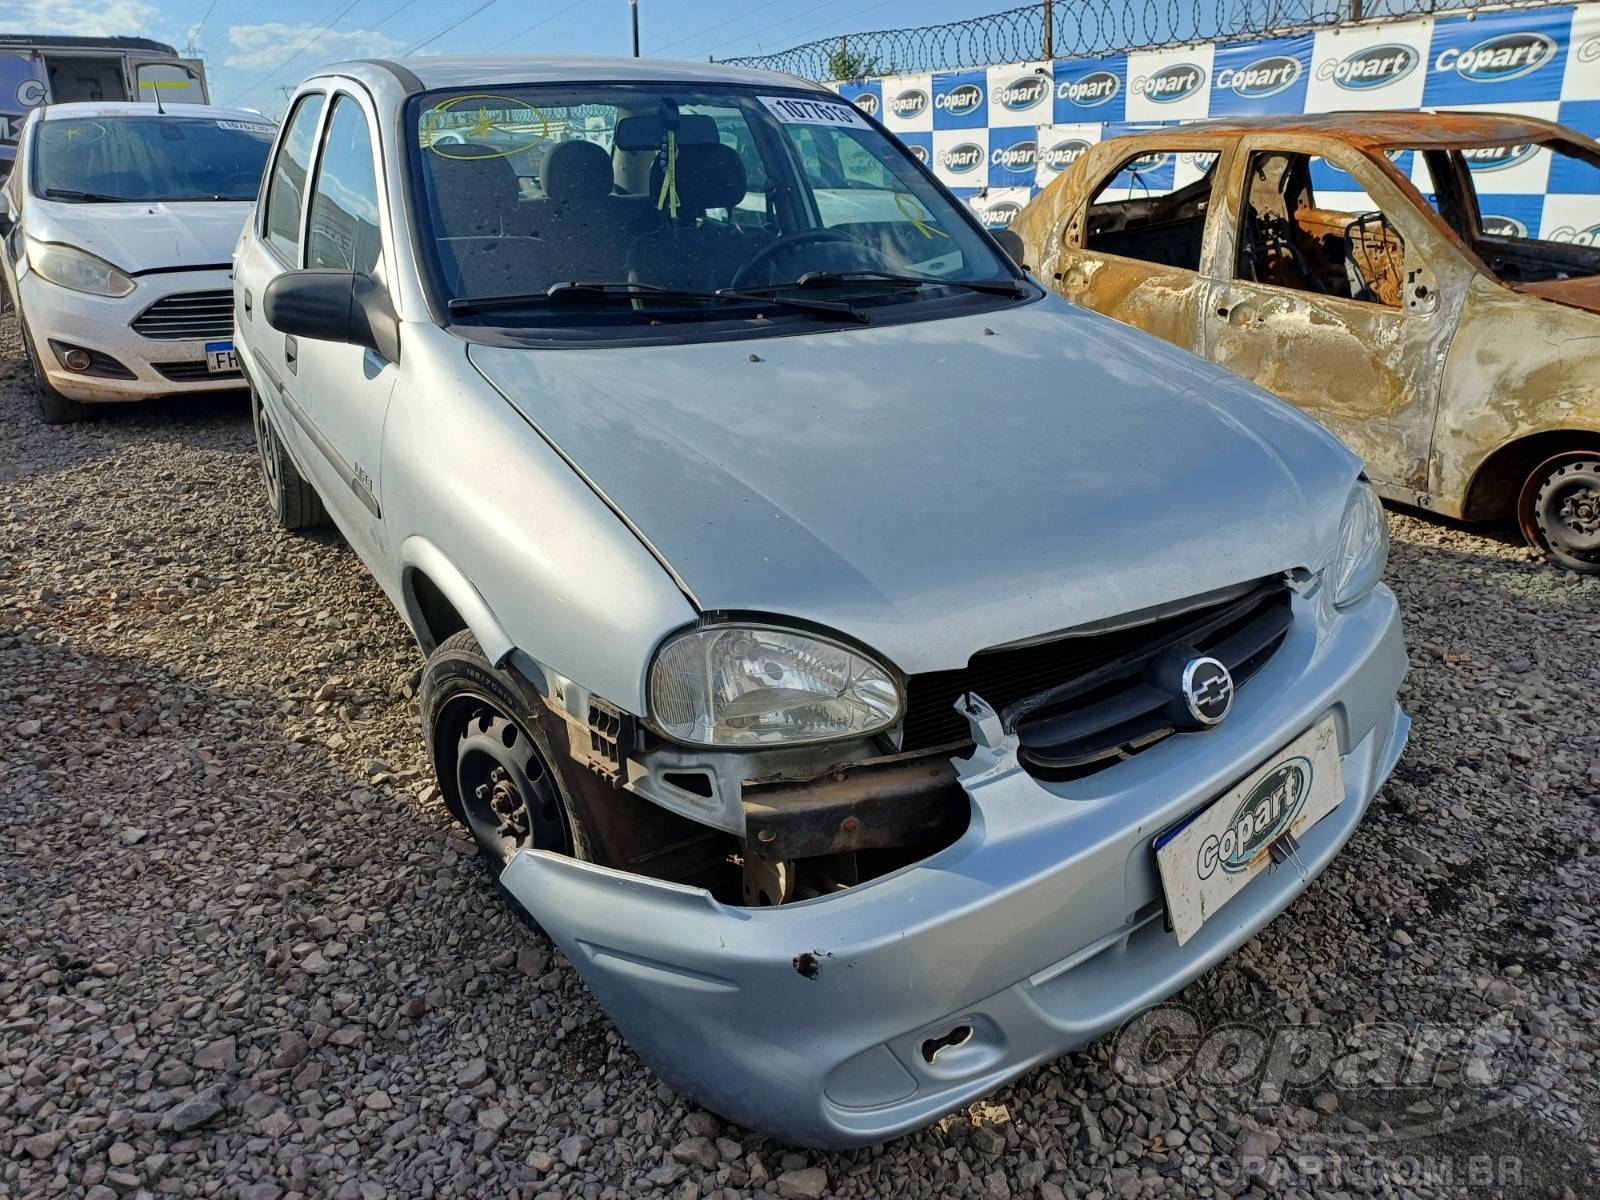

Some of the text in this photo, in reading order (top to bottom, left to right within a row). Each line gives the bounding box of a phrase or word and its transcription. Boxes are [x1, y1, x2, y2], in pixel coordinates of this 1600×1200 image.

[1316, 50, 1409, 82] Copart
[1435, 39, 1545, 76] Copart
[1130, 70, 1196, 95] Copart
[1216, 63, 1296, 89] Copart
[935, 90, 979, 110] Copart
[992, 83, 1042, 105] Copart
[1057, 78, 1115, 102] Copart
[887, 95, 923, 113] Copart
[936, 150, 978, 168] Copart
[1197, 766, 1297, 880] Copart
